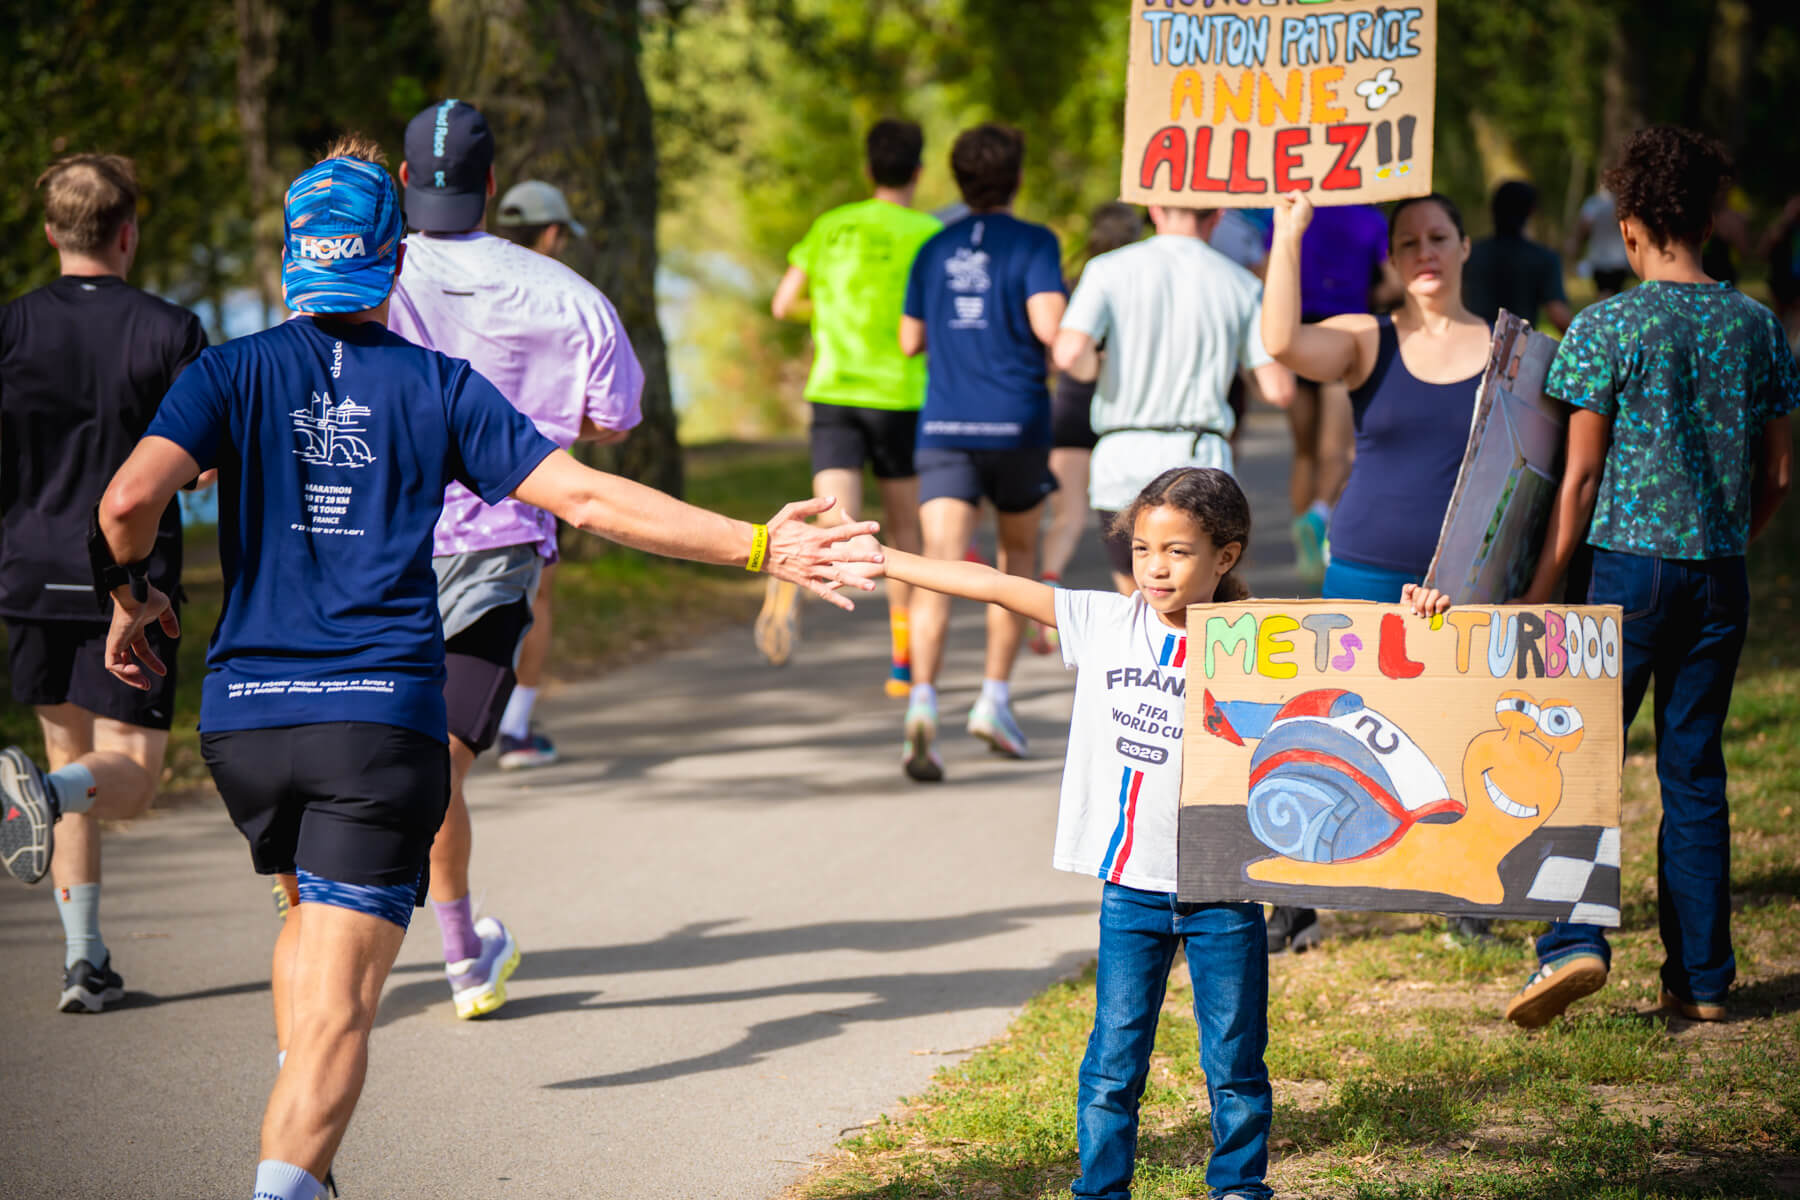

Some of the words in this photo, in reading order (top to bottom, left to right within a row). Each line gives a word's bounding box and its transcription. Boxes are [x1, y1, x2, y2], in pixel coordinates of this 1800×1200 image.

[1141, 10, 1270, 67] TONTON
[1280, 7, 1423, 67] PATRICE
[1169, 65, 1348, 126] ANNE
[300, 237, 366, 260] HOKA
[330, 340, 343, 379] circle
[304, 483, 353, 495] MARATHON
[314, 495, 325, 504] ET
[335, 496, 350, 504] KM
[307, 504, 319, 513] DE
[319, 505, 347, 515] TOURS
[312, 516, 340, 525] FRANCE
[1106, 667, 1186, 699] FRAN
[1112, 706, 1160, 735] WORLD
[1137, 702, 1169, 722] FIFA
[1119, 741, 1163, 762] 2026
